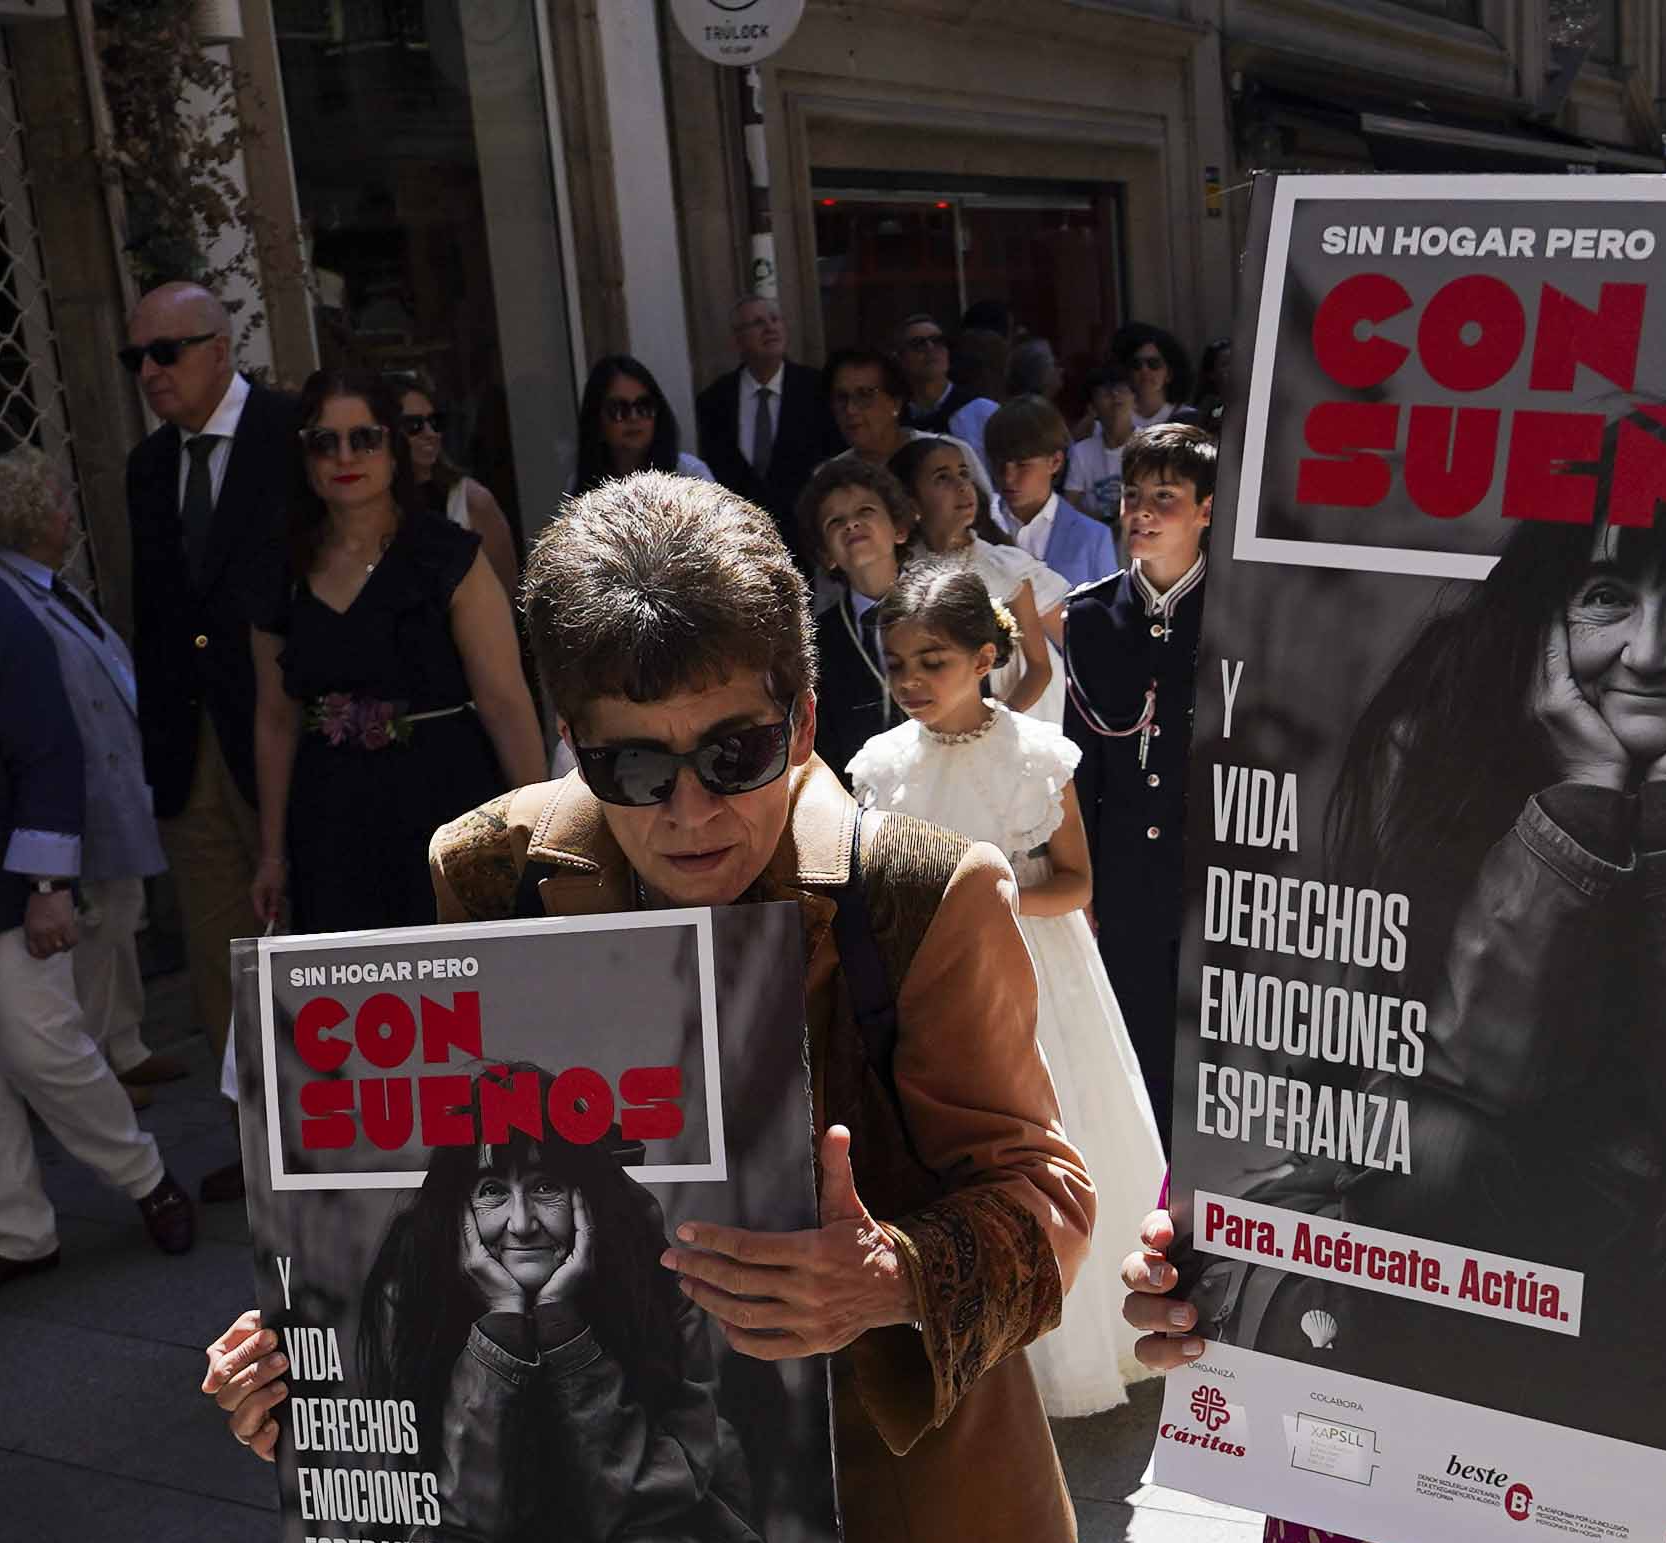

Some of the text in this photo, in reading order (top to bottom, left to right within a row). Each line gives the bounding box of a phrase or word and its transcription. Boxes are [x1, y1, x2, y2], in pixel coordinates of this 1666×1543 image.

[1322, 227, 1655, 260] SIN HOGAR PERO
[1312, 273, 1647, 392] CON
[1221, 660, 1244, 738] Y
[1212, 764, 1298, 853] VIDA
[1204, 865, 1409, 972] DERECHOS
[290, 957, 479, 987] SIN HOGAR PERO
[293, 992, 483, 1073] CON
[1200, 965, 1426, 1077] EMOCIONES
[299, 1065, 685, 1150] SUEÑOS
[1197, 1063, 1412, 1174] ESPERANZA
[276, 1256, 291, 1310] Y
[1205, 1202, 1569, 1322] Para. Acércate. Actúa.
[284, 1327, 344, 1382] VIDA
[291, 1397, 419, 1455] DERECHOS
[1310, 1392, 1364, 1411] COLABORA
[1161, 1424, 1246, 1456] Cáritas
[1446, 1455, 1508, 1488] beste
[297, 1467, 441, 1526] EMOCIONES
